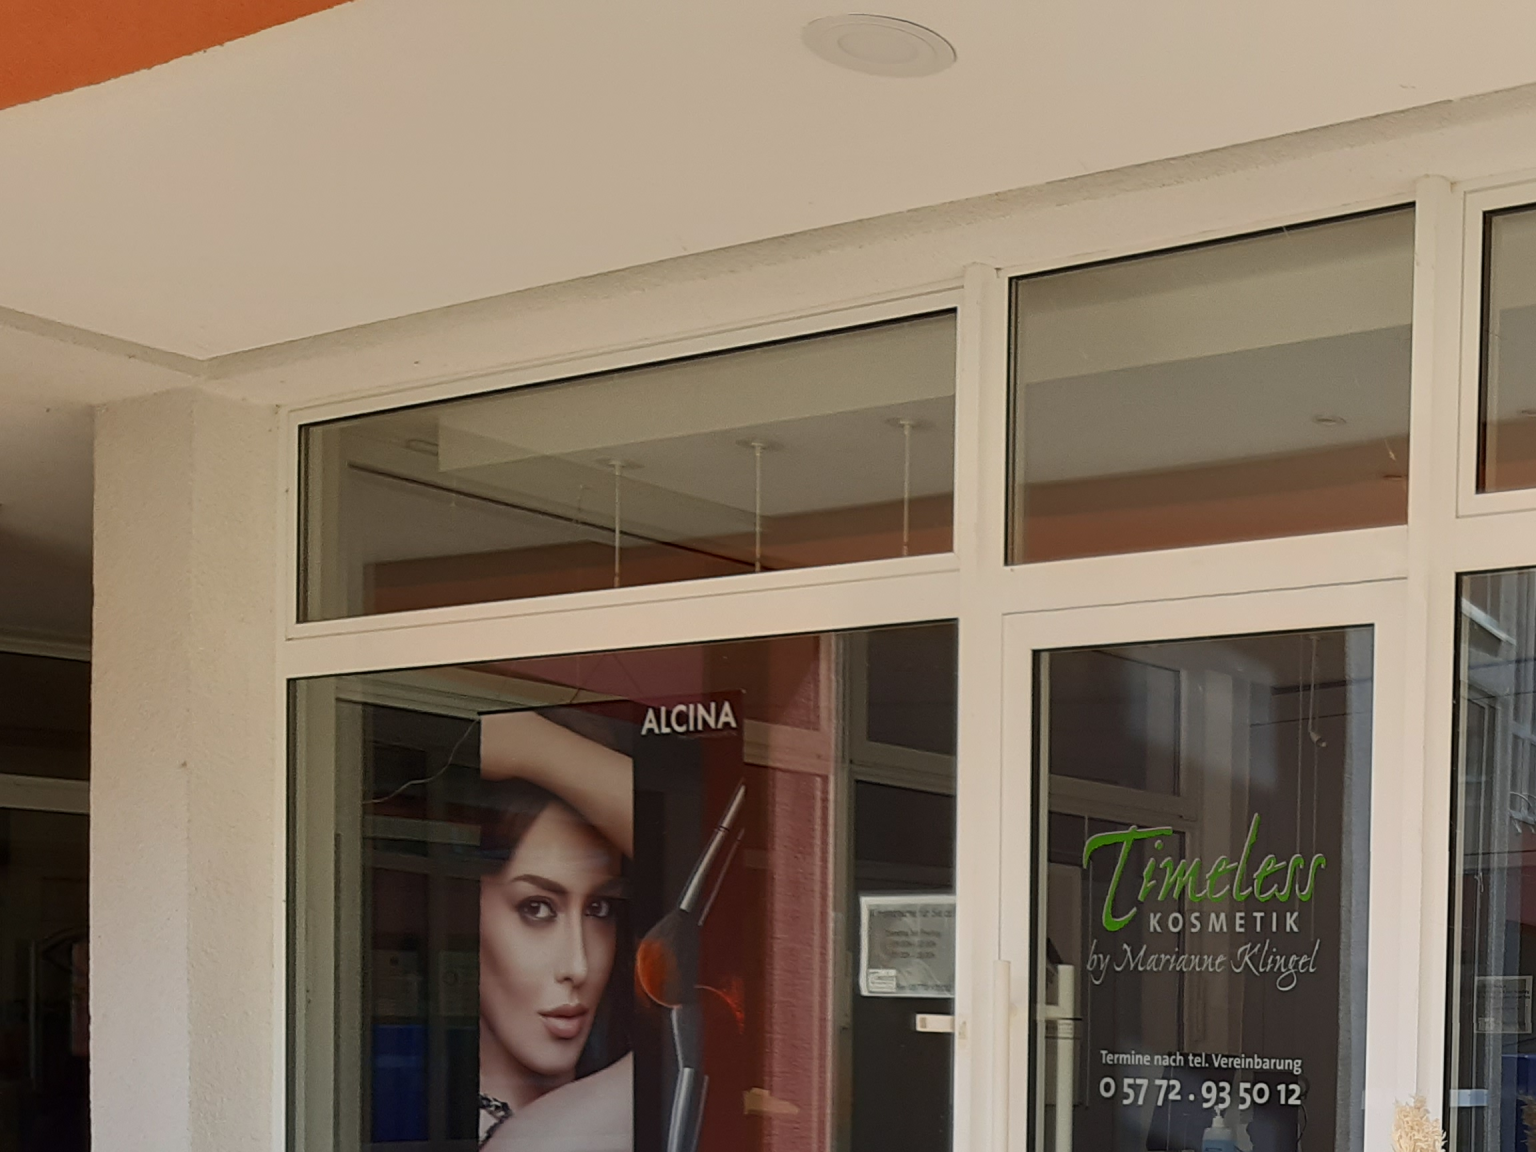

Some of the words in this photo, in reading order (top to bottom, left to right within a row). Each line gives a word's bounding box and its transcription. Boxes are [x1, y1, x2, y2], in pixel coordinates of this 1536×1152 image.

[640, 700, 737, 735] ALCINA
[1082, 812, 1327, 932] Timeless
[1149, 911, 1300, 934] KOSMETIK
[1086, 938, 1111, 985] by
[1113, 942, 1227, 973] Marianne
[1230, 937, 1321, 991] Klingel
[1099, 1050, 1151, 1066] Termine
[1154, 1052, 1185, 1067] nach
[1188, 1052, 1209, 1068] tel.
[1212, 1053, 1303, 1075] Vereinbarung
[1121, 1077, 1149, 1105] 57
[1154, 1078, 1182, 1107] 72
[1200, 1080, 1232, 1110] 93
[1238, 1081, 1270, 1110] 50
[1276, 1083, 1302, 1105] 12
